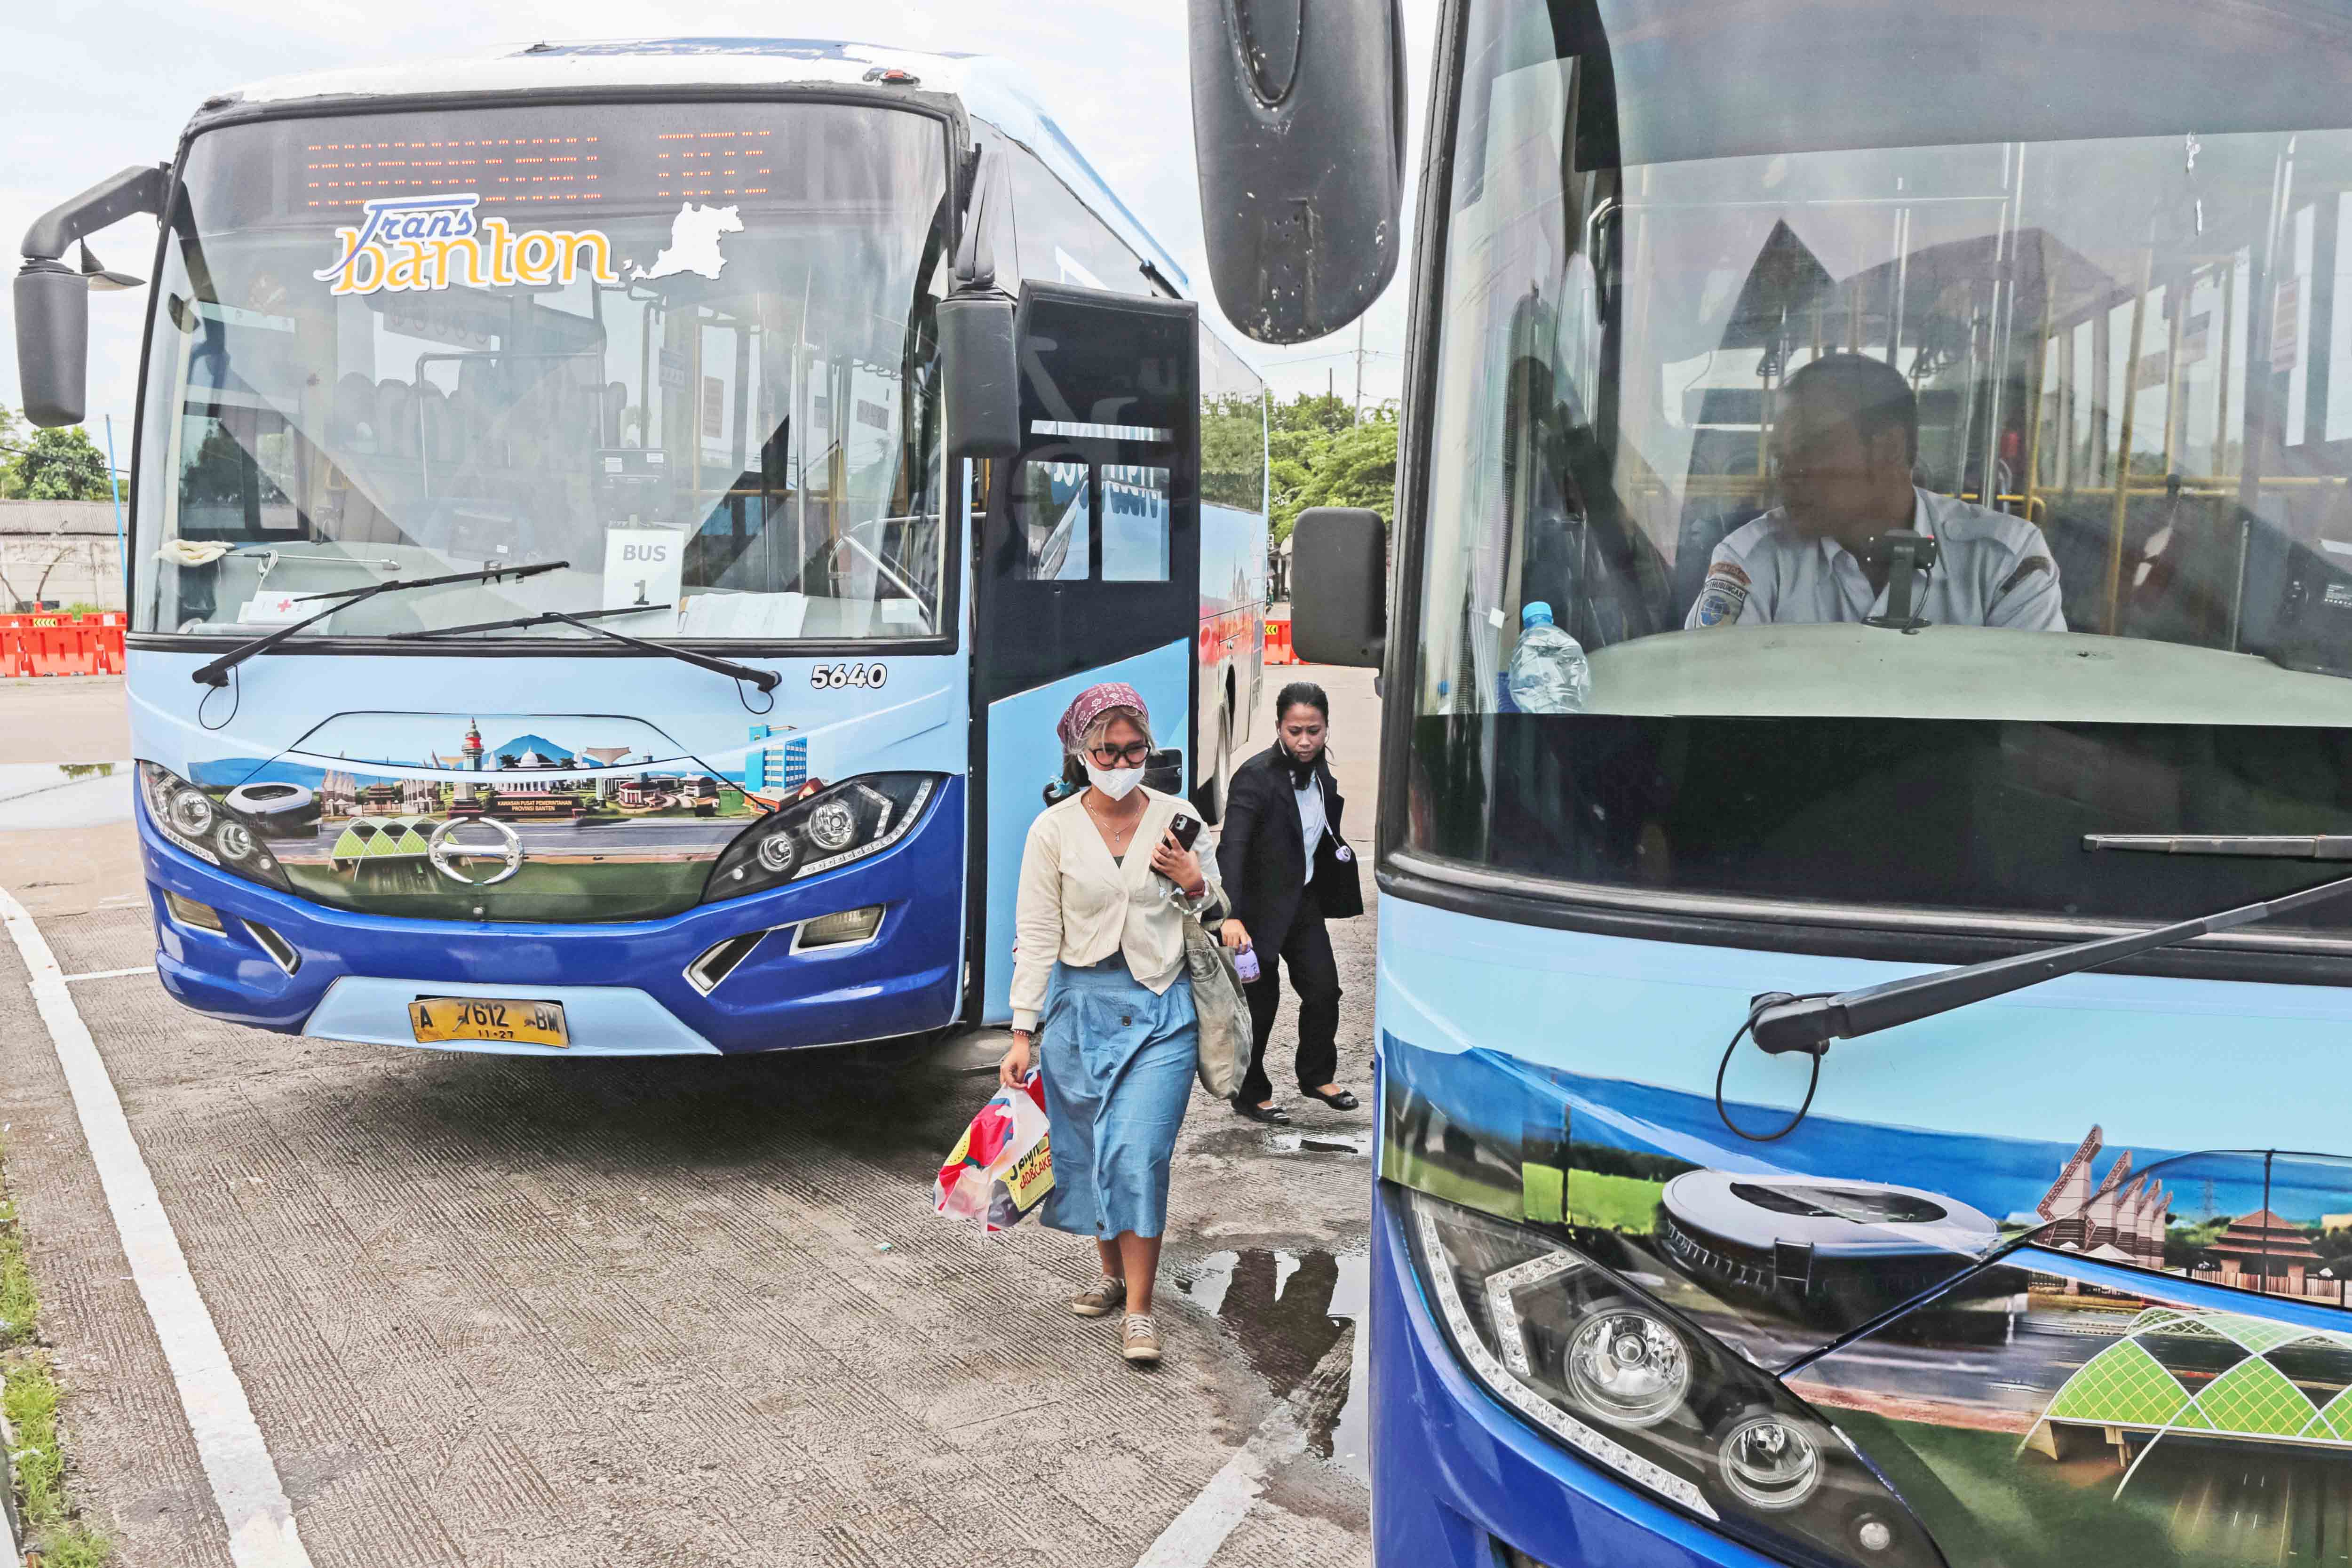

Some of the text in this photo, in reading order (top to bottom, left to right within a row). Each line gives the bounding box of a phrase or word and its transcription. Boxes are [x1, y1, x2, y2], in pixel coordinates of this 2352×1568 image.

[321, 196, 476, 273] Trans
[335, 221, 620, 293] banten
[623, 544, 666, 562] BUS
[632, 579, 650, 605] 1
[810, 663, 888, 690] 5640
[420, 1004, 433, 1028] A
[457, 1002, 509, 1027] 7612
